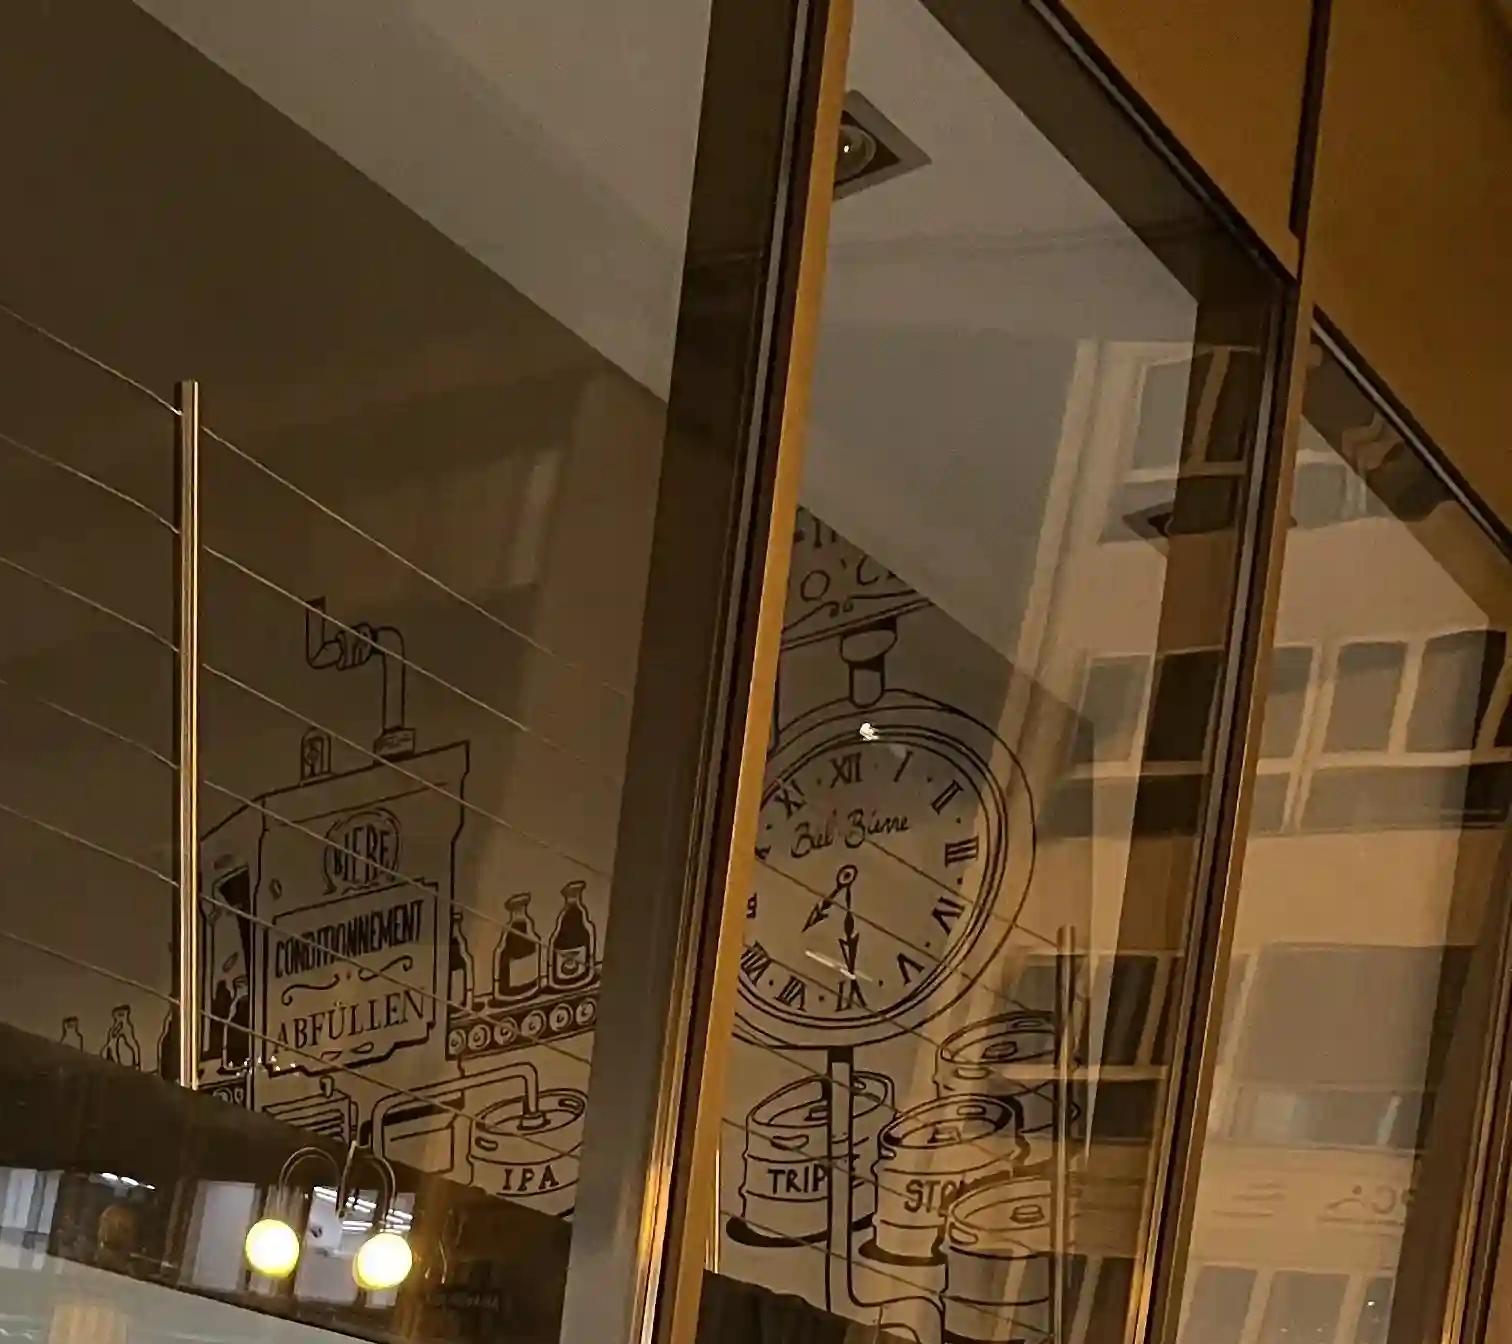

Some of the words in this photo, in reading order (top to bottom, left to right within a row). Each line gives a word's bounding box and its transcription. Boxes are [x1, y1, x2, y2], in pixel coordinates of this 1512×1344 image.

[275, 900, 424, 979] CONDITIONNEMENT
[274, 985, 425, 1055] ABFÜLLEN
[502, 1165, 560, 1191] IPA
